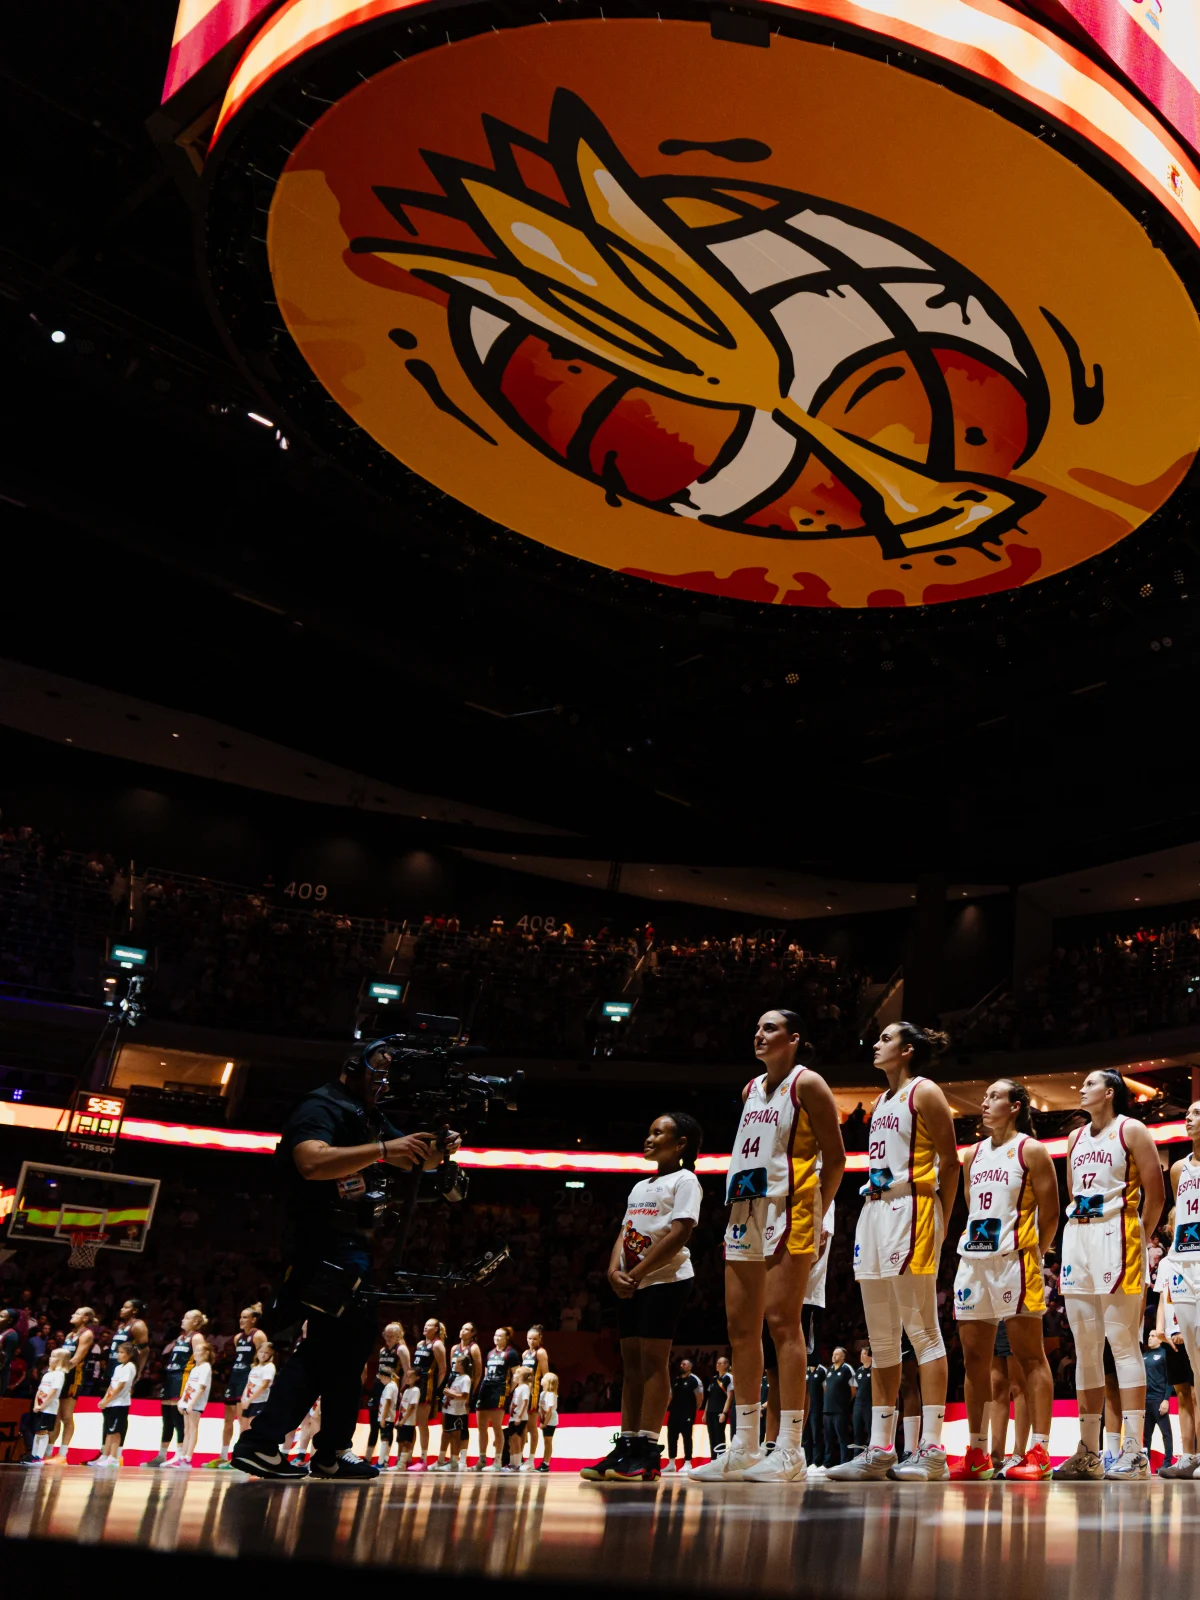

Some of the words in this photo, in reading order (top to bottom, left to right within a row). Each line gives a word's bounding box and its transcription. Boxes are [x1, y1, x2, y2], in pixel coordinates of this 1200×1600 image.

[283, 881, 328, 901] 409
[516, 914, 556, 933] 408
[80, 1142, 116, 1155] TISSOT
[741, 1136, 760, 1159] 44
[869, 1140, 886, 1160] 20
[1073, 1149, 1113, 1170] ESPAÑA
[1081, 1172, 1097, 1190] 17
[978, 1191, 993, 1210] 18
[1186, 1198, 1199, 1216] 14
